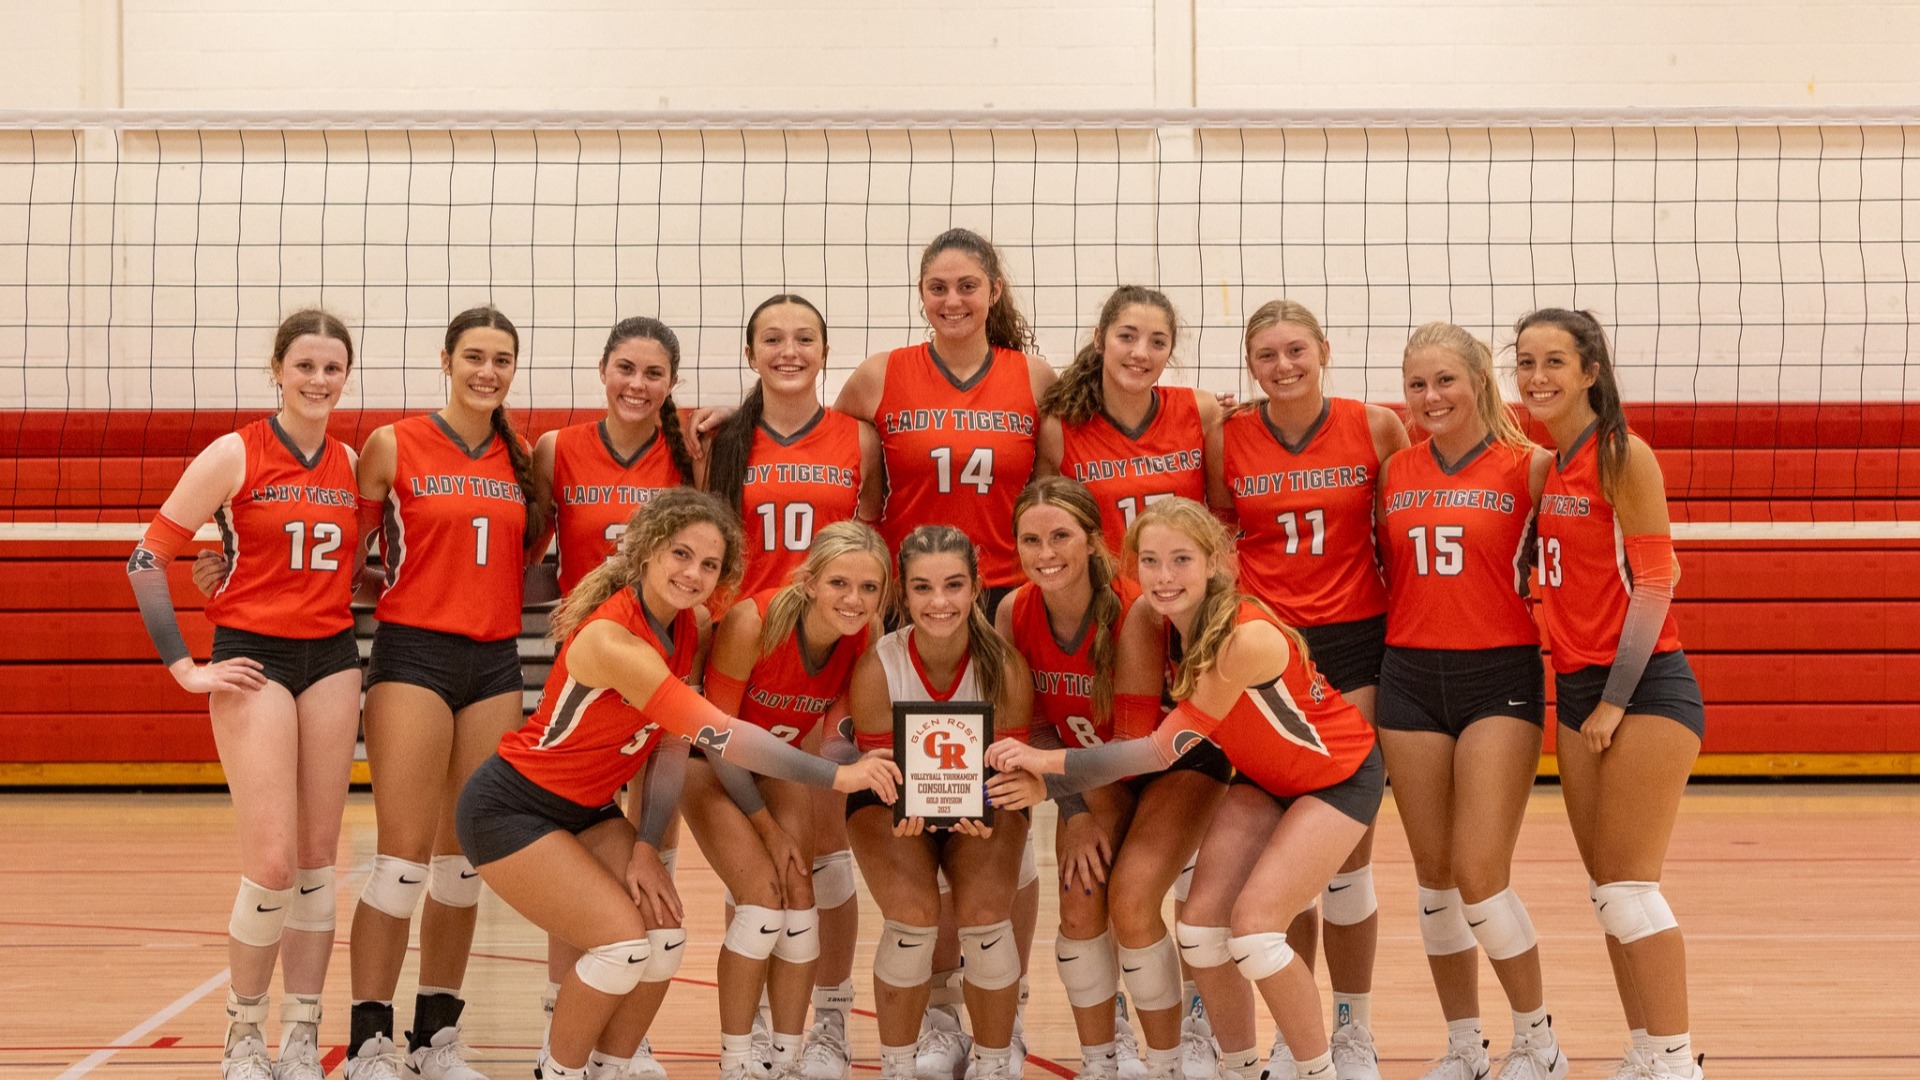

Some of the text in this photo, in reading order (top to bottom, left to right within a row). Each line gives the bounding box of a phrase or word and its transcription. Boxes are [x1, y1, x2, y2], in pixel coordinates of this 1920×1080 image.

[886, 408, 1034, 436] LADY TIGERS
[743, 463, 854, 488] DY TIGERS
[930, 446, 995, 495] 14
[1074, 449, 1203, 483] LADY TIGERS
[252, 485, 358, 510] LADY TIGERS
[411, 475, 526, 506] LADY TIGER
[563, 485, 615, 505] LADY
[1235, 465, 1368, 499] LADY TIGERS
[1386, 489, 1516, 516] LADY TIGERS
[471, 516, 490, 567] 1
[756, 502, 815, 552] 10
[1277, 509, 1326, 556] 11
[284, 520, 343, 571] 12
[1408, 525, 1465, 577] 15
[1537, 536, 1563, 588] 13
[746, 683, 794, 709] LADY
[911, 718, 978, 744] GLEN ROSE
[1066, 715, 1106, 748] 8
[923, 731, 969, 770] GR
[910, 773, 978, 781] VOLLEYBALL TOURNAMENT
[917, 783, 971, 794] CONSOLATION
[926, 797, 962, 805] GOLD DIVISION
[937, 806, 951, 814] 2023
